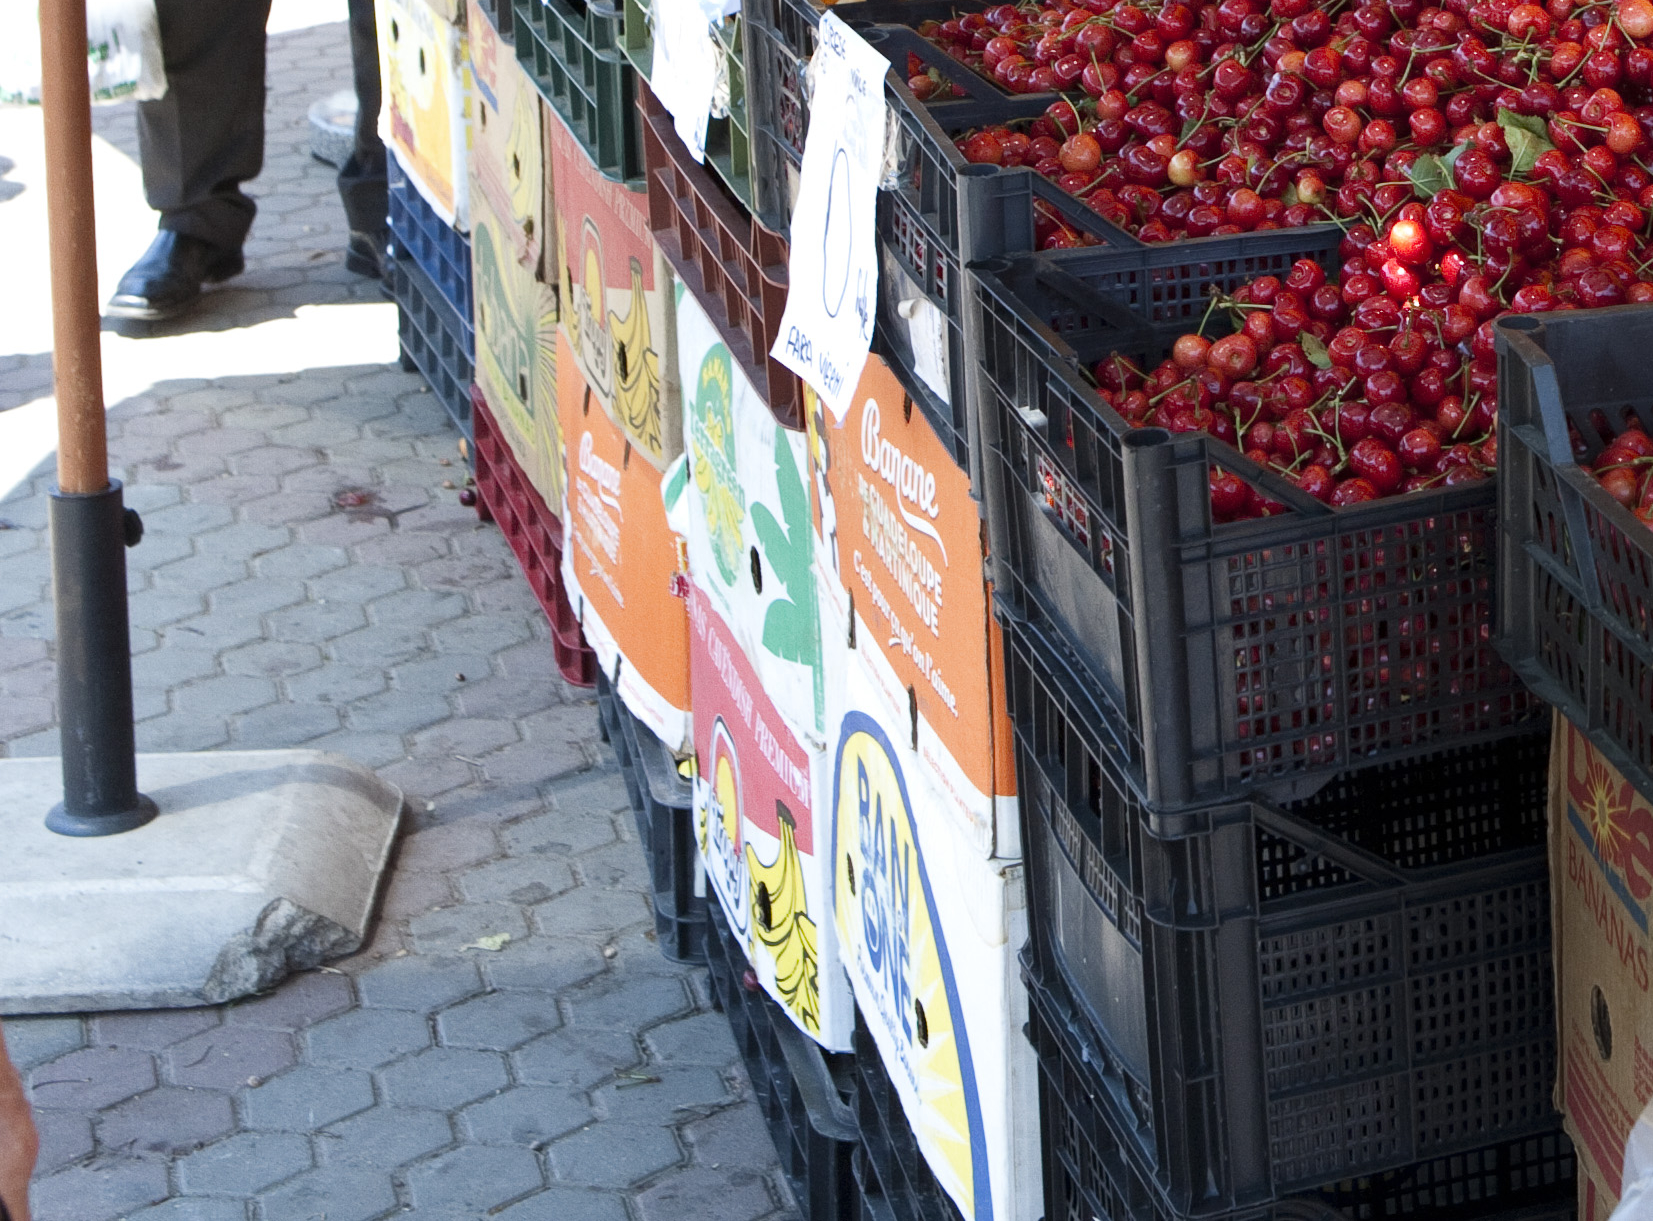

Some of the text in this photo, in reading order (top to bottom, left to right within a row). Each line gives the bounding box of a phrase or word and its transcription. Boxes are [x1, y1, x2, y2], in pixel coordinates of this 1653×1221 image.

[861, 398, 948, 568] Banane
[869, 483, 943, 607] GUADELOUPE
[870, 524, 940, 639] MARTINIQUE
[1568, 836, 1648, 993] BANANAS
